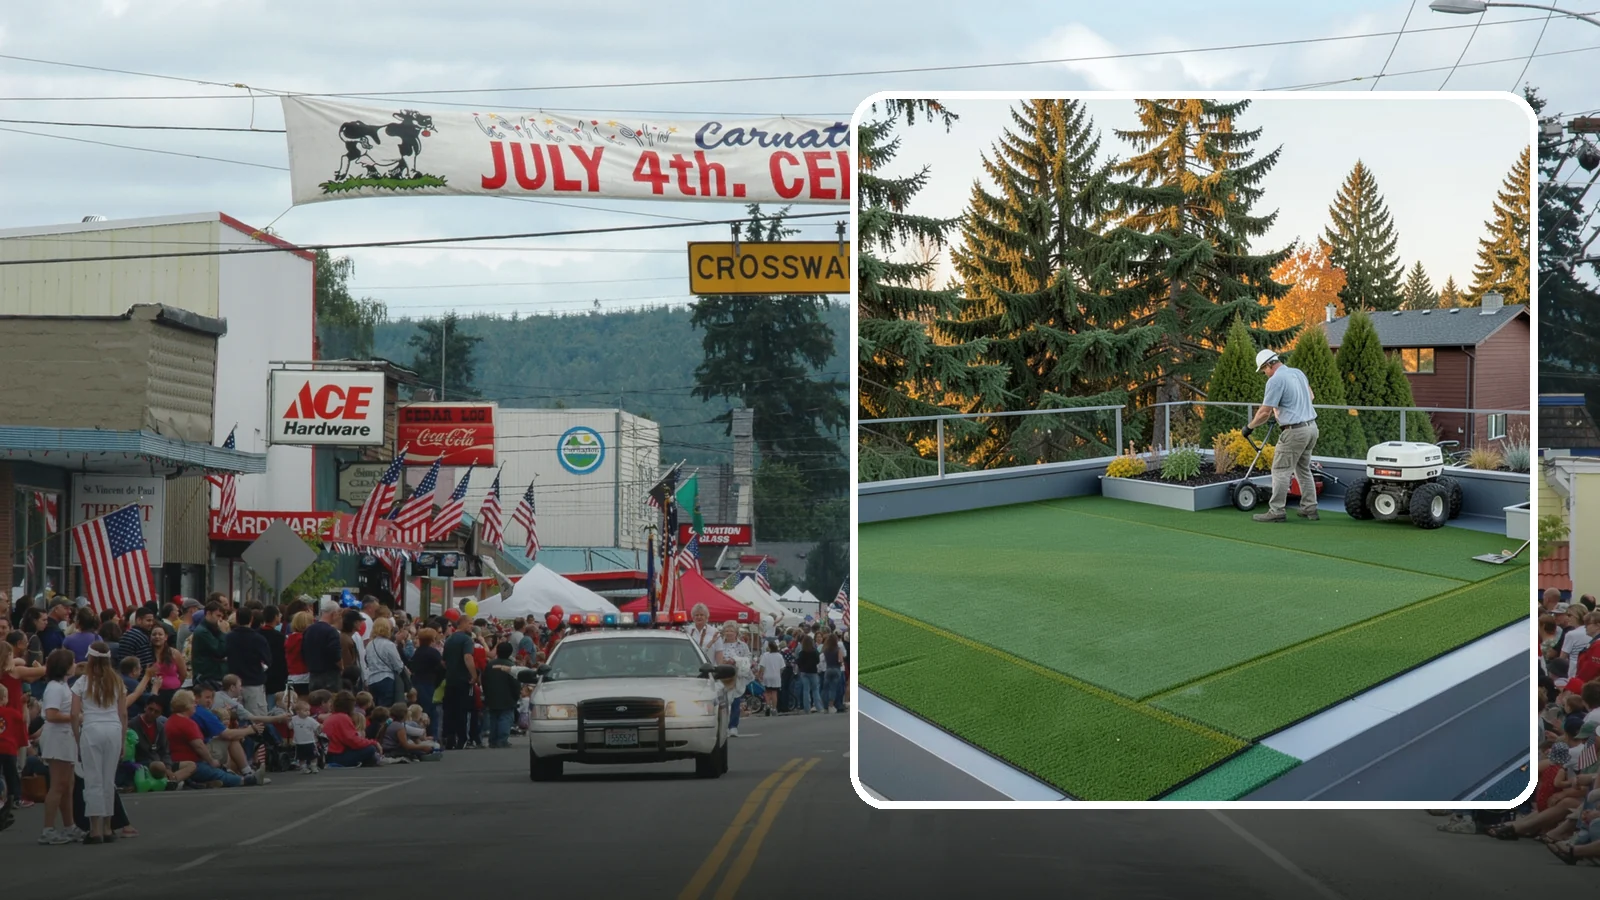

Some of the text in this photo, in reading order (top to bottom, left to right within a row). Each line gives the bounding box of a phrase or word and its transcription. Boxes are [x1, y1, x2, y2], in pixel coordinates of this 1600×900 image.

[695, 121, 850, 150] Carnat
[481, 140, 605, 193] JULY
[632, 150, 747, 198] 4th.
[697, 254, 850, 280] CROSSWA
[282, 379, 374, 420] ACE
[405, 409, 485, 422] CEDAR LOG
[283, 421, 371, 437] Hardware
[416, 428, 477, 447] Coca-Cola
[353, 467, 386, 480] Simpl
[83, 485, 155, 496] St. Vincent de Paul
[81, 503, 154, 522] THRT
[212, 516, 331, 536] HARDARE
[687, 526, 741, 535] CRNATION
[699, 535, 730, 544] GLASS
